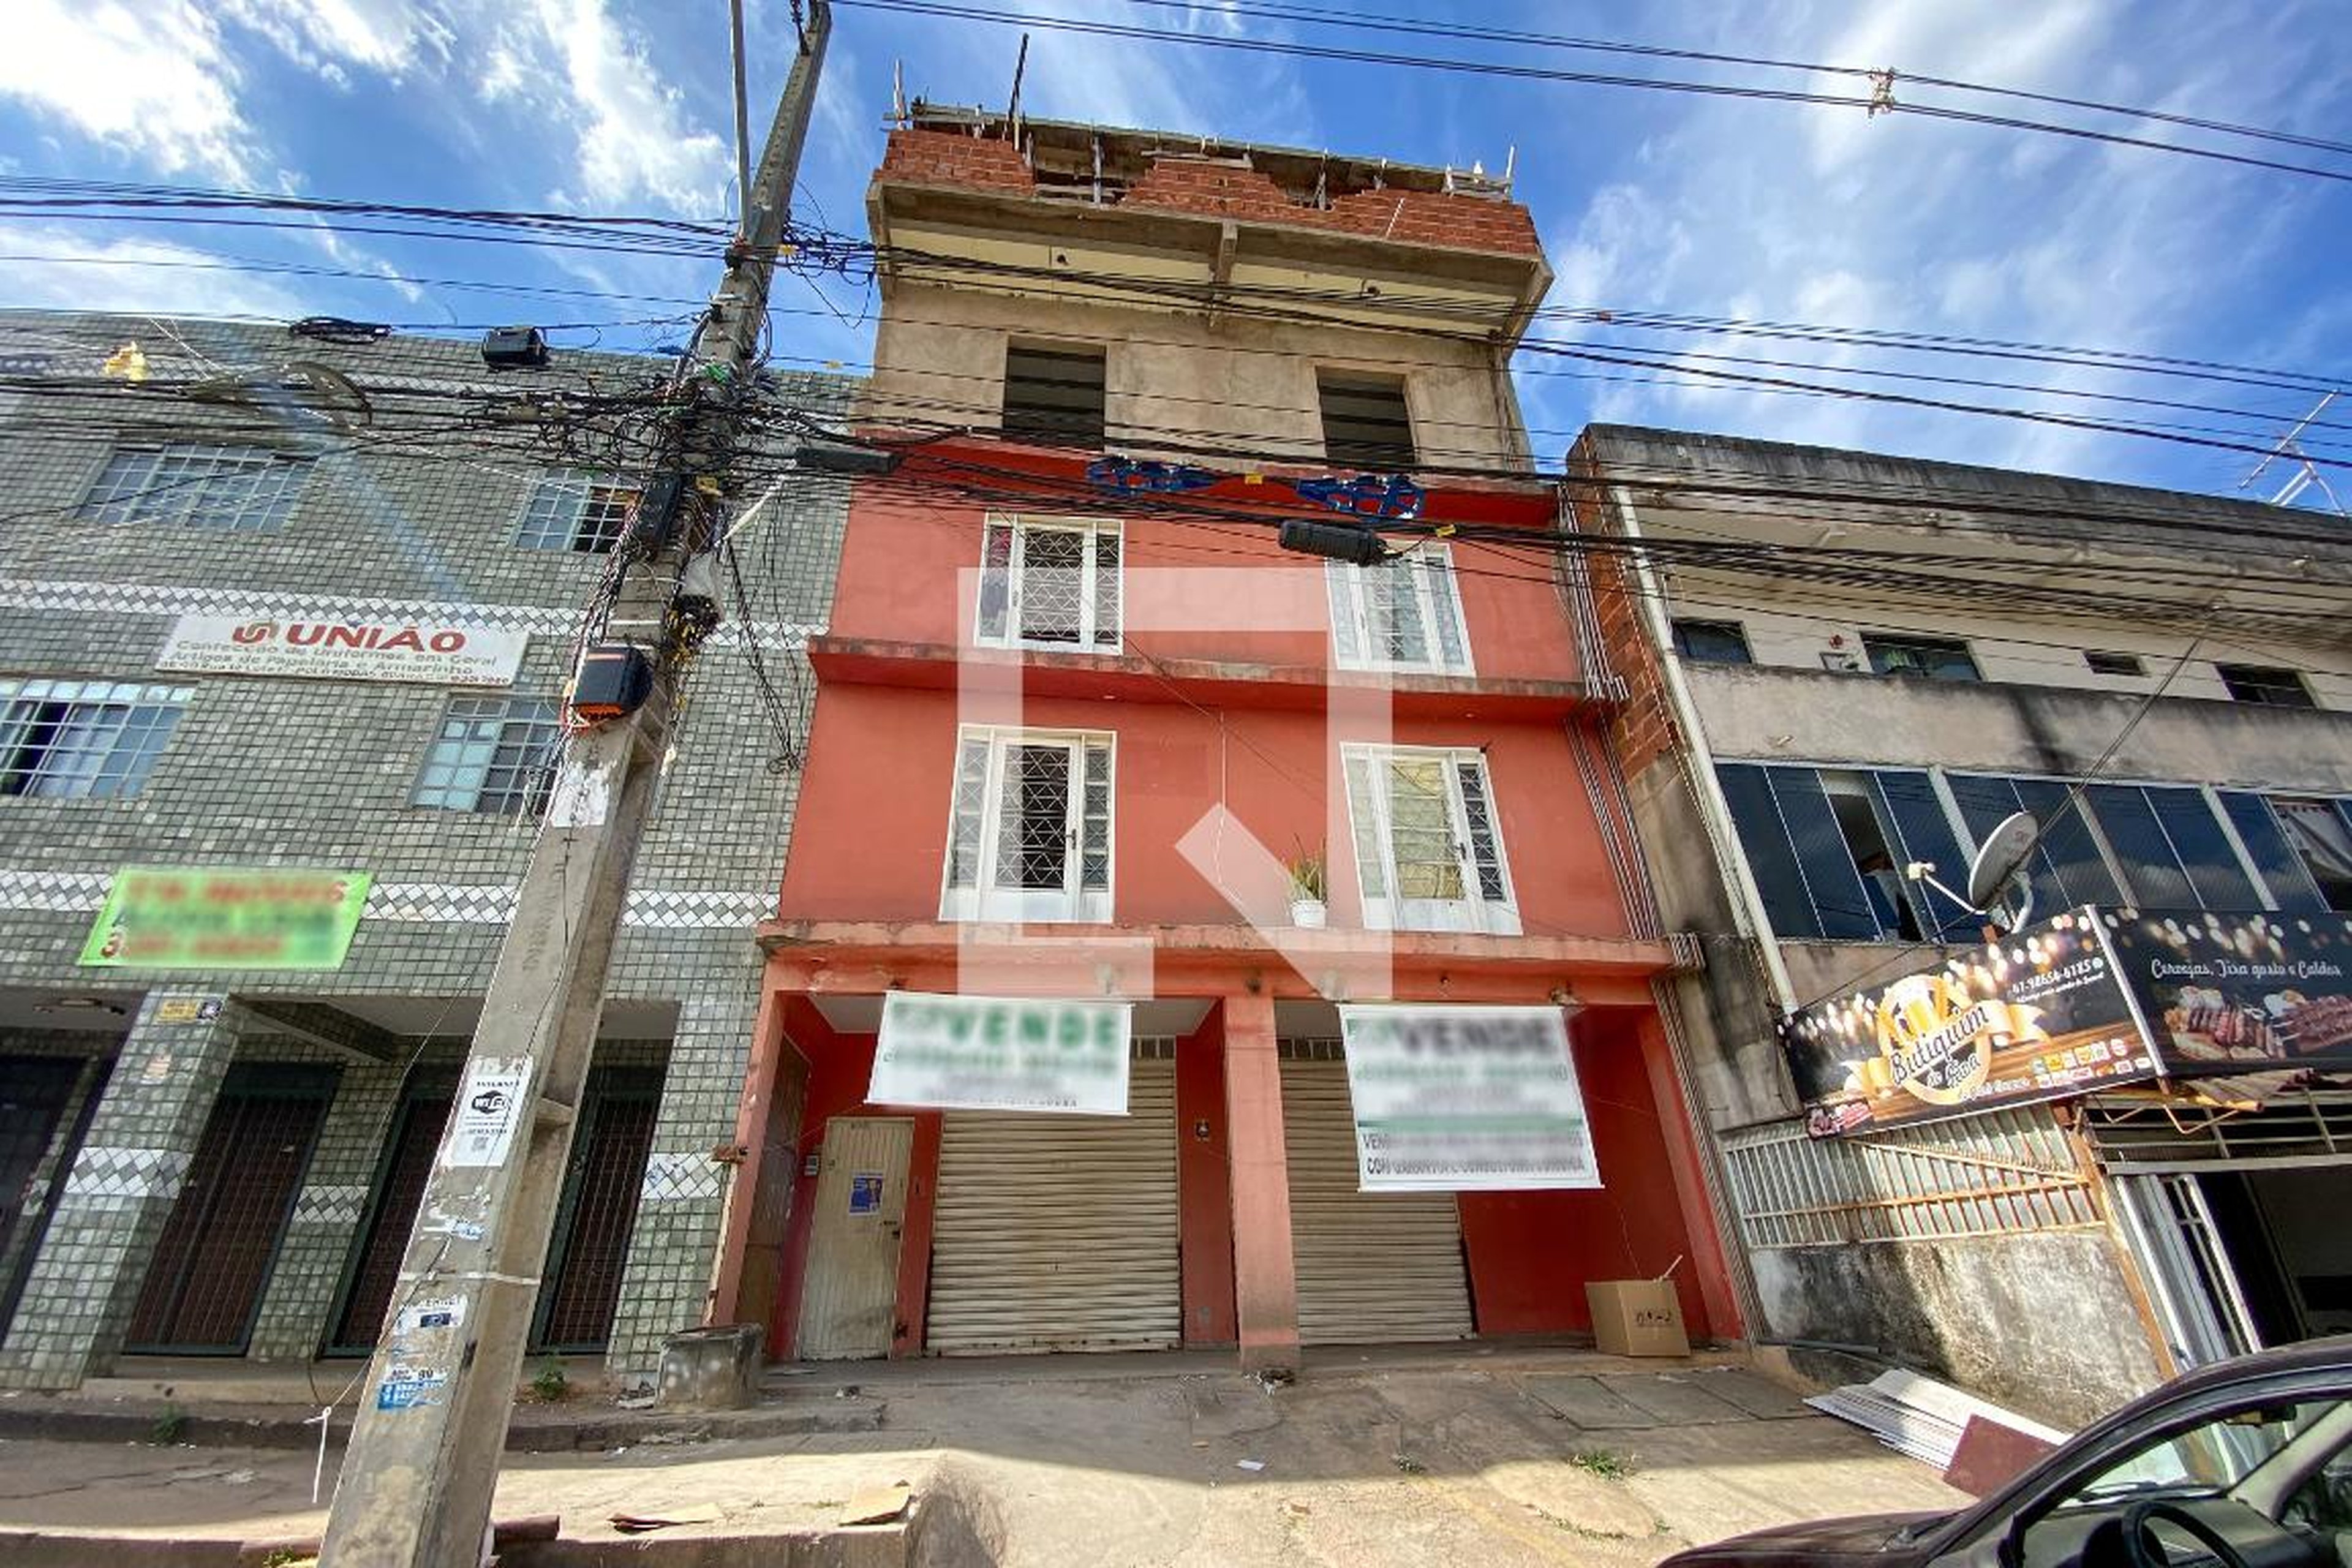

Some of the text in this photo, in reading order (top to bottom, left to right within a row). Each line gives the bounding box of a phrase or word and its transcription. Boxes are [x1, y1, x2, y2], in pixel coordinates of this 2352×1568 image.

[286, 621, 467, 653] UNIÃO
[170, 652, 233, 663] Artigos
[239, 654, 262, 664] de
[266, 655, 350, 669] Papelaria
[284, 647, 306, 656] de
[313, 647, 405, 661] Uniformes
[415, 654, 443, 663] em
[450, 654, 498, 666] Geral
[1891, 1006, 1989, 1085] Butiquim
